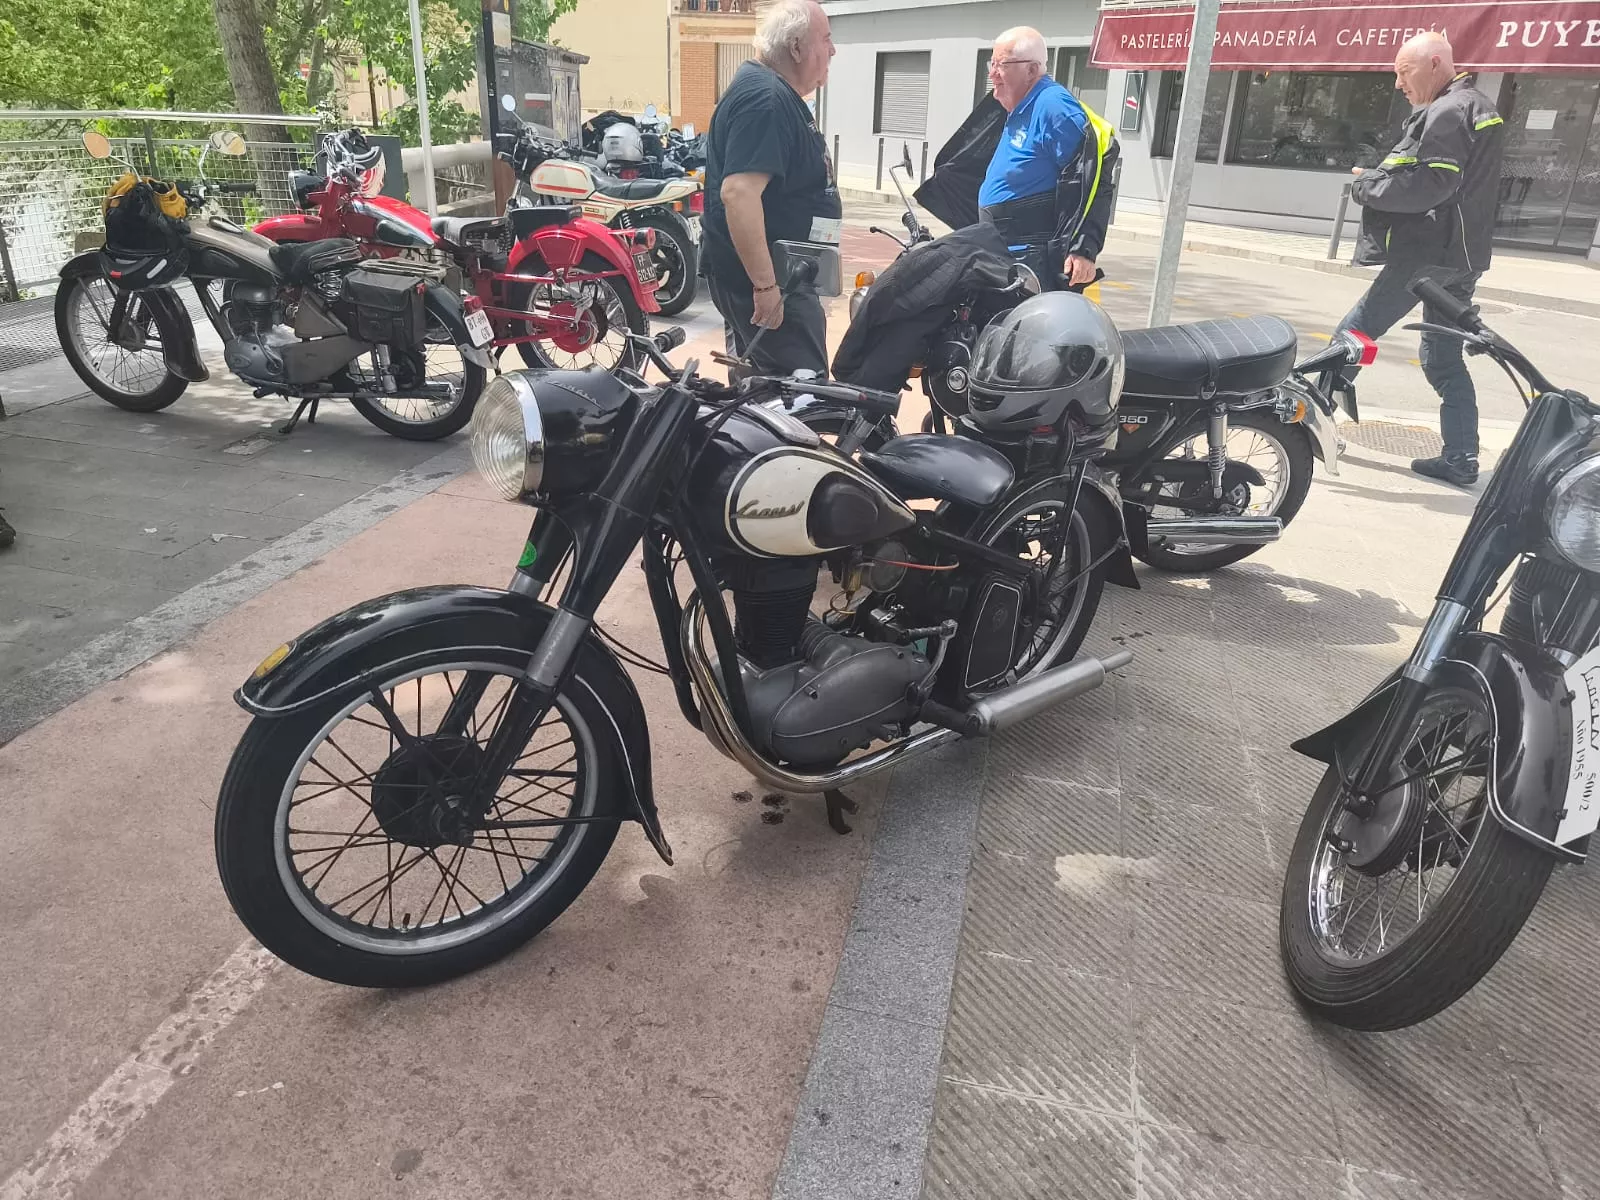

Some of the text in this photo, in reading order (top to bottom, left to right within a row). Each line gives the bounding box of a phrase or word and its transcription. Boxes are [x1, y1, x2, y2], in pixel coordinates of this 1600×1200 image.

[1212, 24, 1318, 47] PANADERÍA
[1119, 415, 1148, 424] 350
[1573, 748, 1586, 780] 1955
[1578, 772, 1597, 812] 500/2
